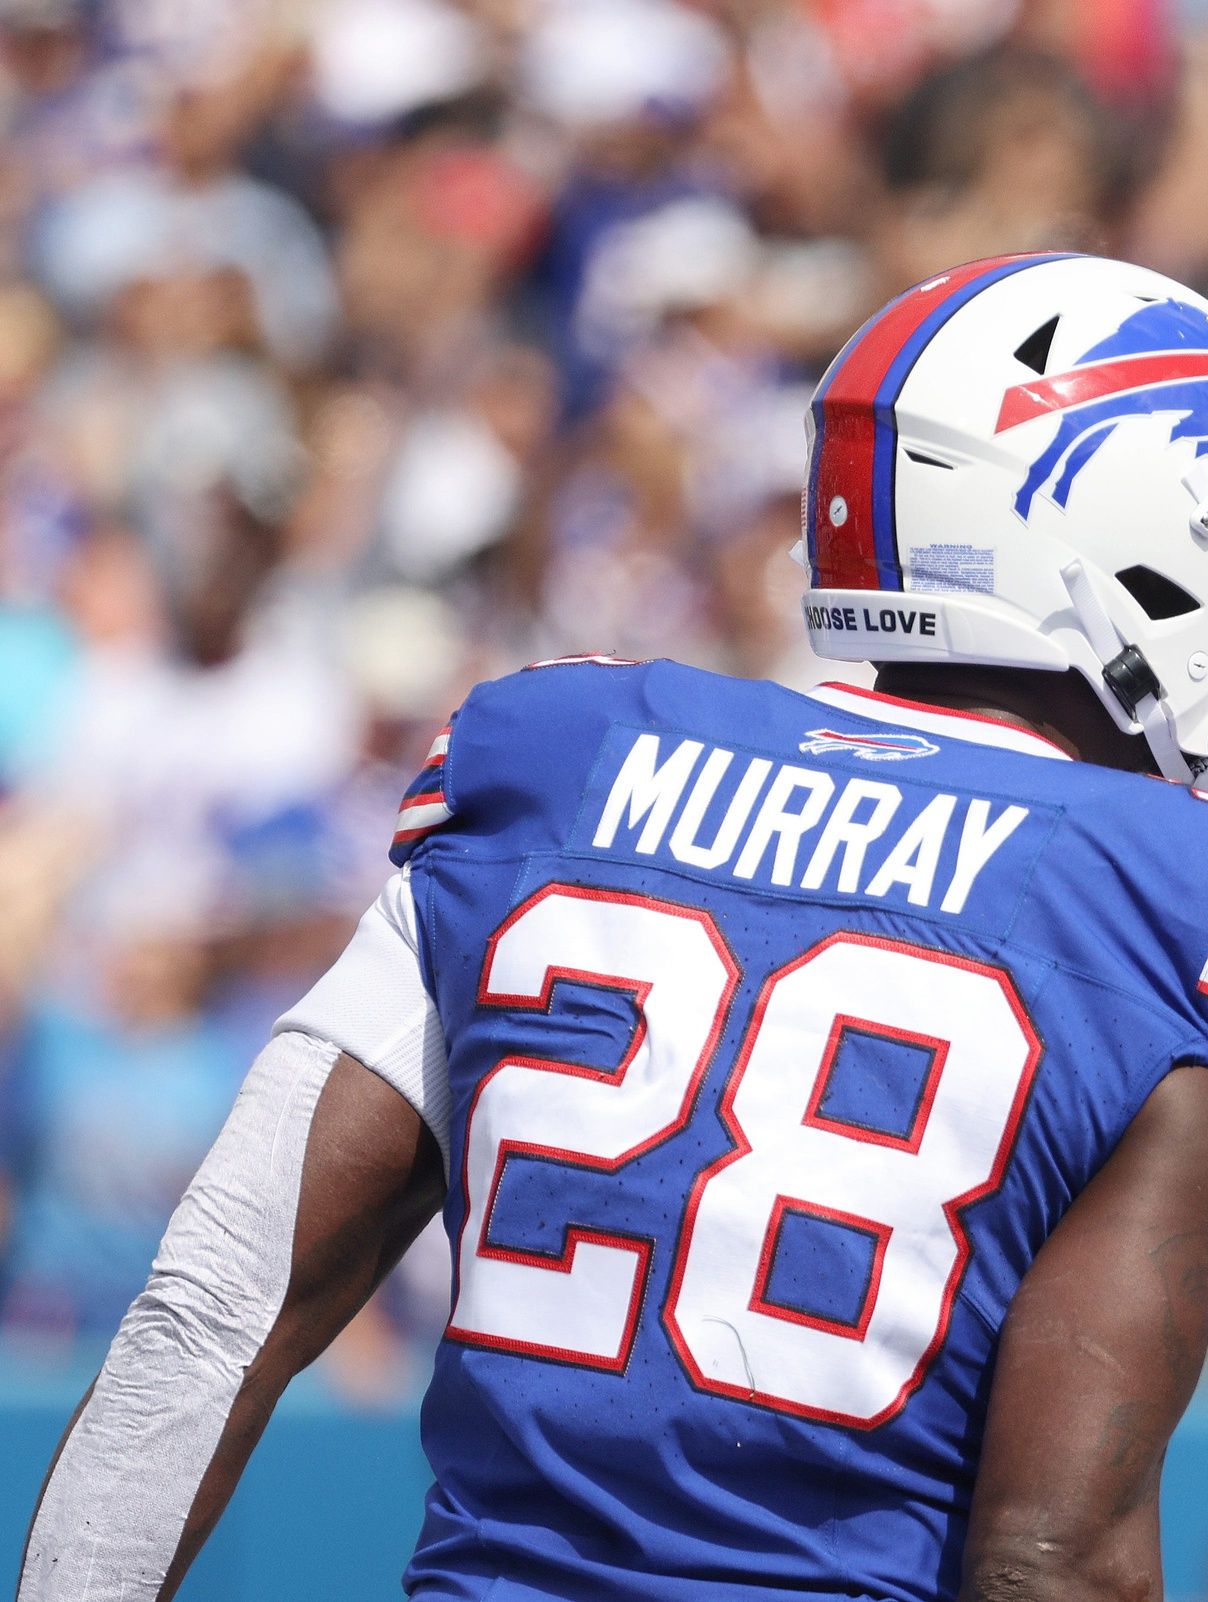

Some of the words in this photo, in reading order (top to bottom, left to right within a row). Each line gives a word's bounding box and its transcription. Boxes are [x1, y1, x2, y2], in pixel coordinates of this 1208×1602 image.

[863, 608, 936, 636] LOVE
[592, 734, 1029, 914] MURRAY
[444, 882, 1044, 1431] 28
